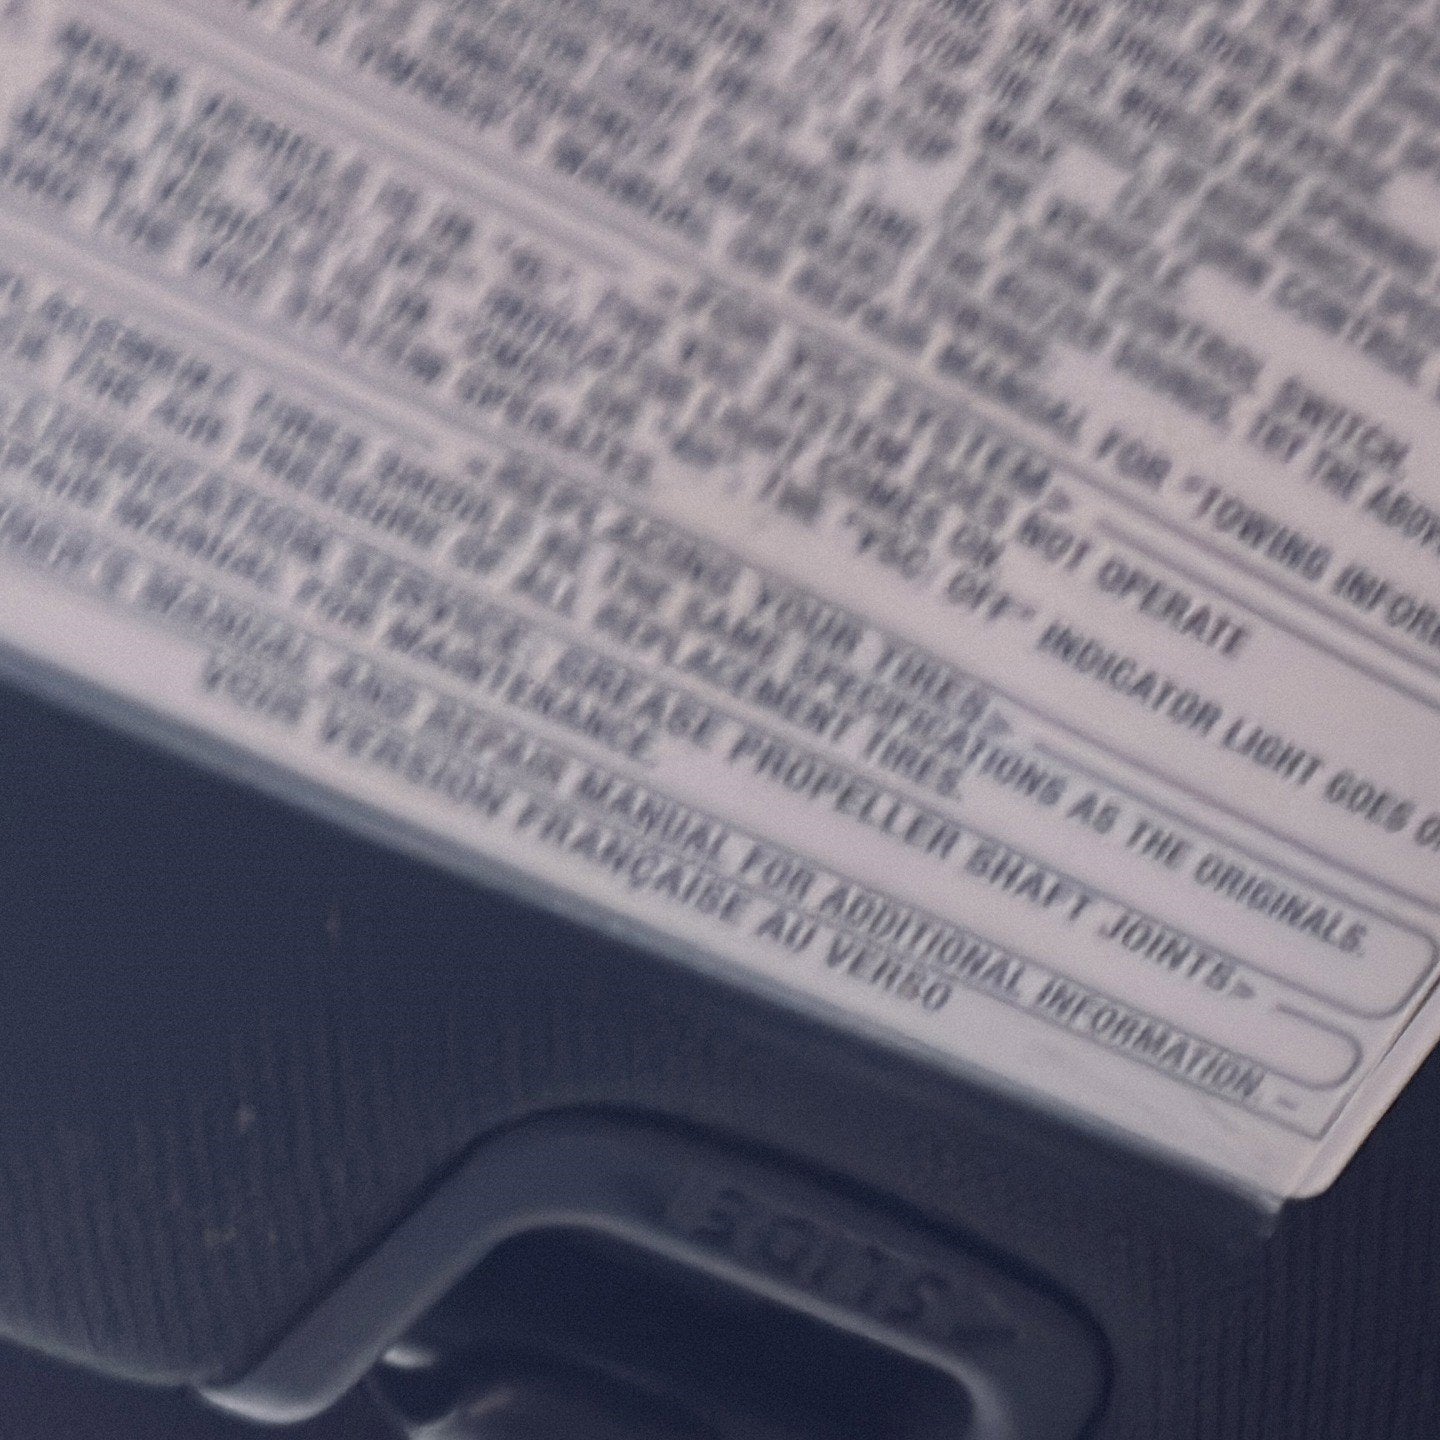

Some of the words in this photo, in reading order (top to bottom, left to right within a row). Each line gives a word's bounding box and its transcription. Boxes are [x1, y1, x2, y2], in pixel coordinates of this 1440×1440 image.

[1091, 428, 1176, 491] FOR
[1302, 448, 1368, 501] THE
[1010, 513, 1091, 571] NOT
[1087, 555, 1254, 659] OPERATE
[1029, 618, 1229, 739] INDICATOR
[1216, 713, 1327, 788] LIGHT
[1317, 765, 1420, 836] GOES
[725, 731, 963, 860] PROPELLER
[961, 843, 1095, 922] SHAFT
[1064, 789, 1124, 836] AS
[1123, 819, 1194, 870] THE
[1187, 850, 1380, 961] ORIGINALS.
[739, 845, 822, 901] FOR
[817, 880, 1033, 997] ADDITIONAL
[1029, 977, 1275, 1106] INFORMATION.
[754, 908, 819, 954] AU
[818, 937, 956, 1016] VERSO
